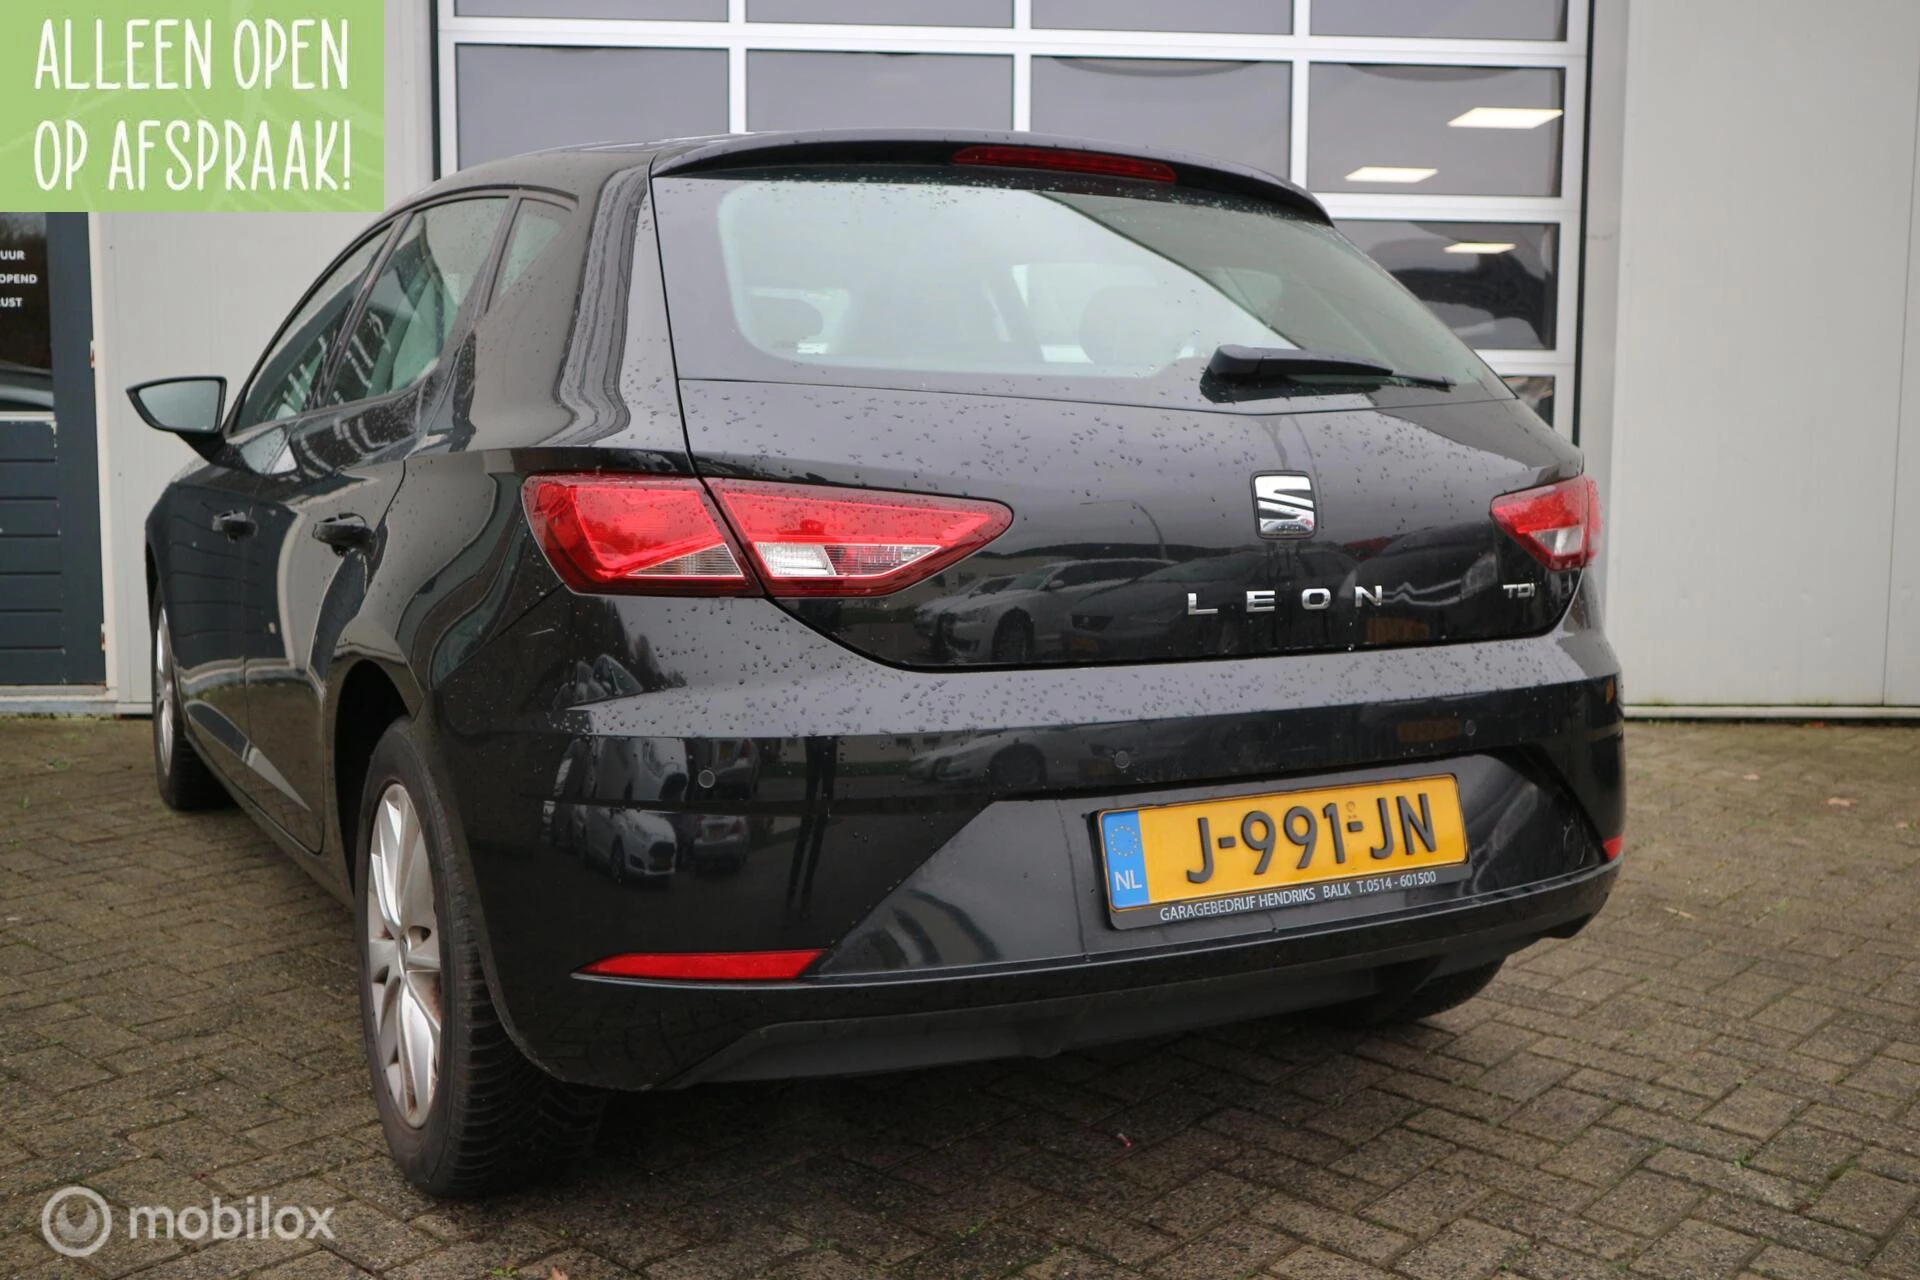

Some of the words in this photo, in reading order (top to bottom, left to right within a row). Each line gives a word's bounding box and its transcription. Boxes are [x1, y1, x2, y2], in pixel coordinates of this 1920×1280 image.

[0, 297, 23, 308] UST
[1187, 585, 1384, 616] LEON
[1502, 582, 1536, 599] TDI
[1186, 793, 1437, 885] J-991-JN
[1114, 870, 1143, 892] NL
[1160, 895, 1256, 921] GARAGEBEDRIJF
[1259, 887, 1317, 908] HENDRIKS
[1322, 882, 1352, 899] BALK
